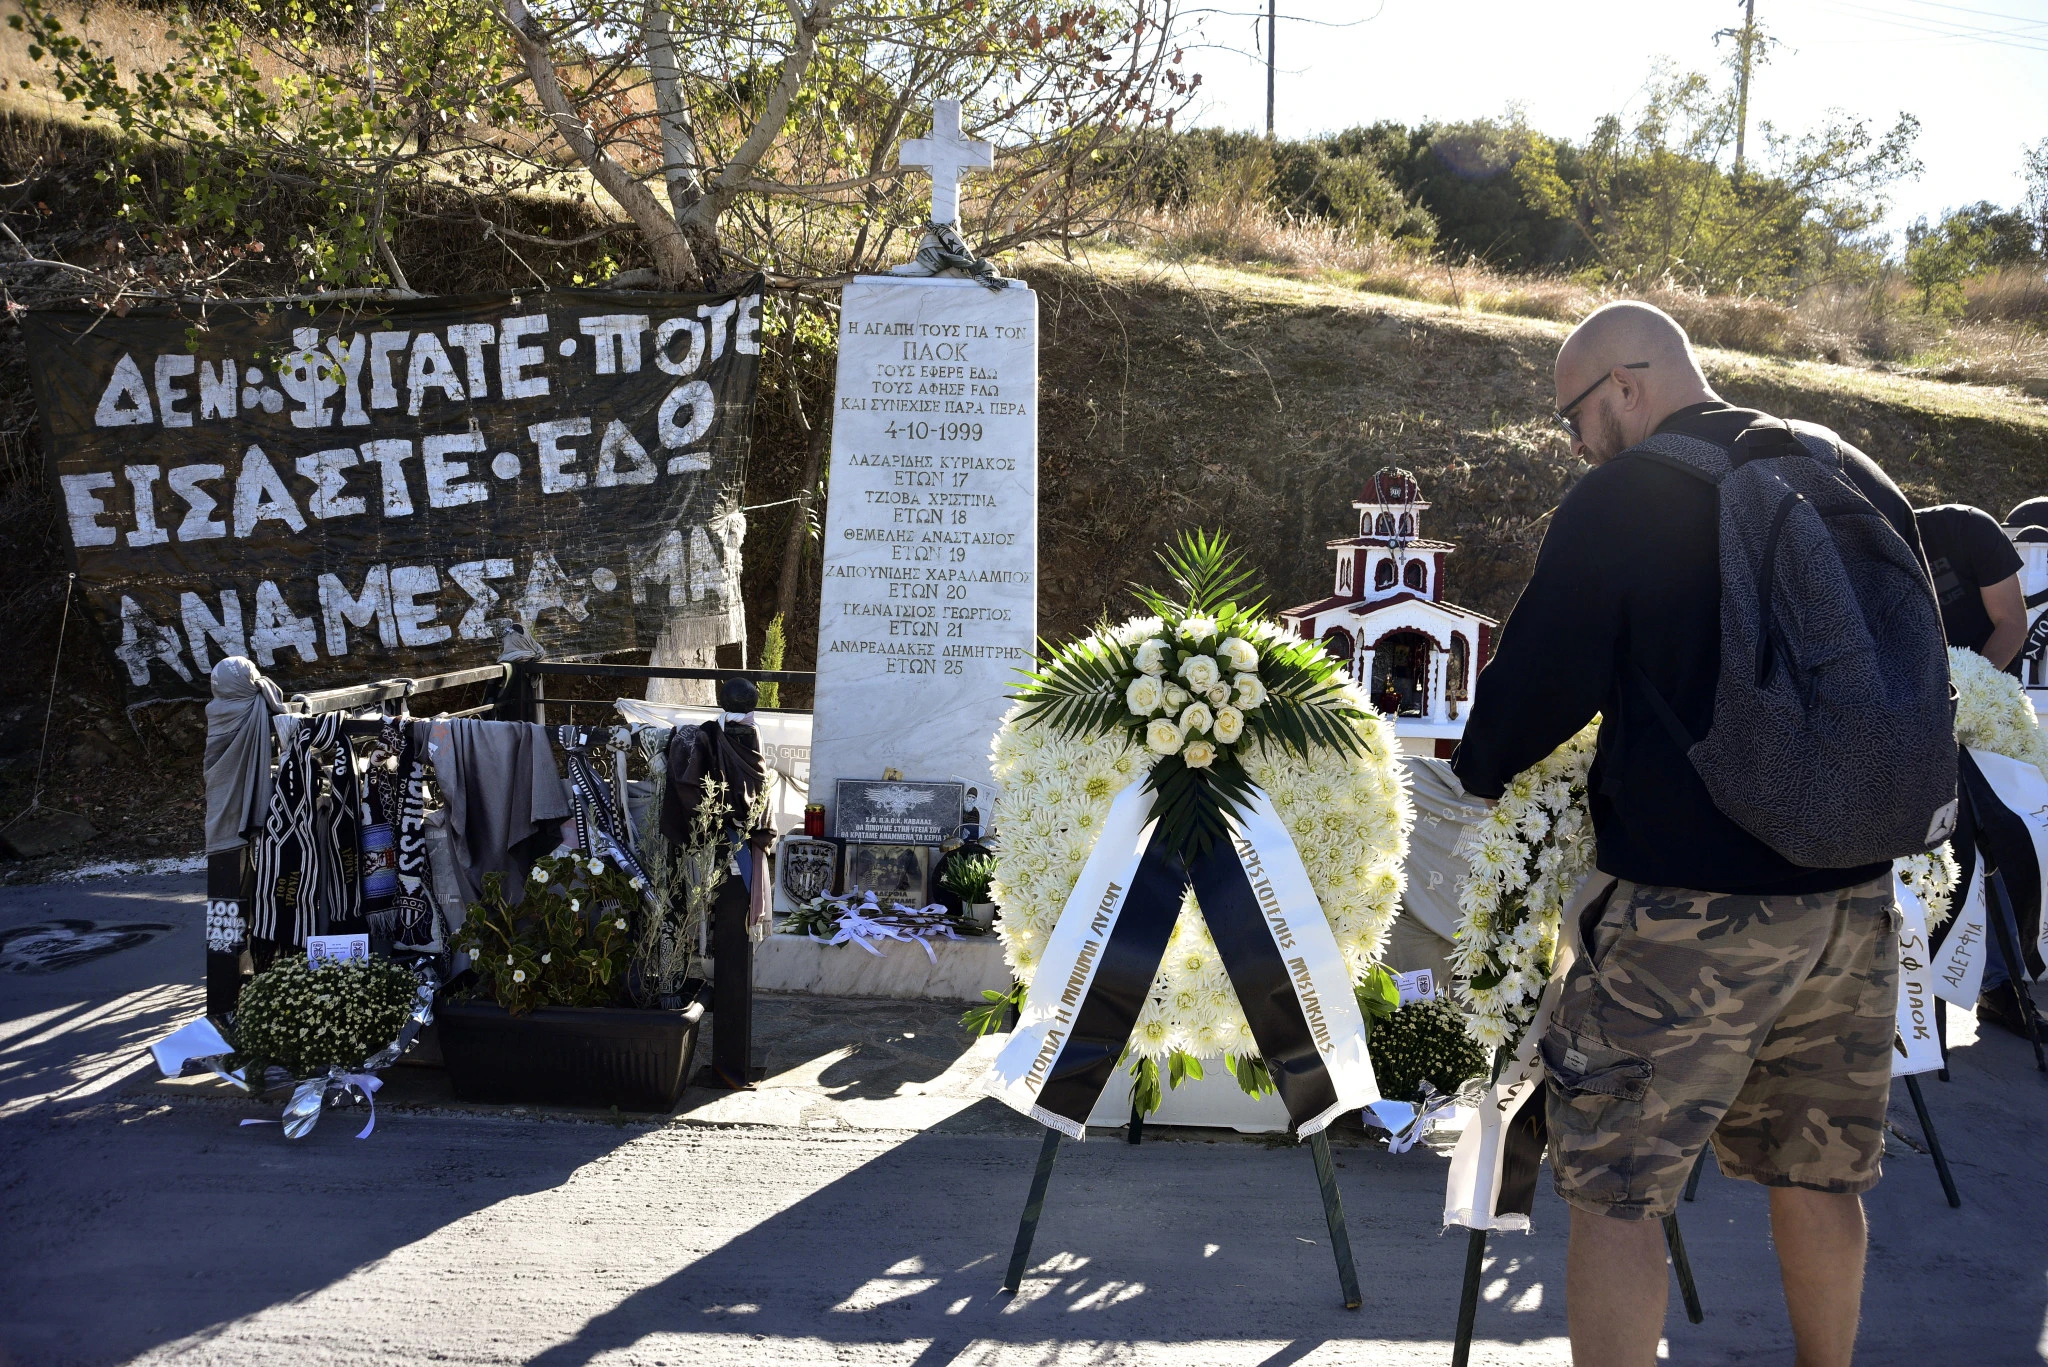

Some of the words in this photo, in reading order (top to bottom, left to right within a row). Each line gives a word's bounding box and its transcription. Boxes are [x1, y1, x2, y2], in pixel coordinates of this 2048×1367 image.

[848, 322, 858, 334] Η
[864, 322, 914, 336] ΑΓΑΠΗ
[920, 324, 960, 337] ΤΟΥΣ
[966, 326, 988, 338] ΓΙΑ
[995, 327, 1027, 339] ΤΟΝ
[903, 341, 968, 362] ΠΑΟΚ
[94, 354, 238, 428] ΔΕΝ
[280, 313, 550, 429] ΦΥΓΑΤΕ
[578, 294, 761, 377] ΠΟΤΕ
[877, 365, 914, 377] ΤΟΥΣ
[921, 366, 963, 379] ΕΦΕΡΕ
[970, 367, 998, 379] ΕΔΩ
[872, 382, 912, 394] ΤΟΥΣ
[918, 383, 965, 396] ΑΦΗΣΕ
[841, 398, 866, 410] ΚΑΙ
[871, 399, 940, 413] ΣΥΝΕΧΙΣΕ
[945, 401, 984, 414] ΠΑΡΑ
[991, 403, 1026, 415] ΠΕΡΑ
[885, 421, 983, 441] 4-10-1999
[849, 454, 932, 468] ΛΑΖΑΡΙΔΗΣ
[940, 457, 1015, 470] ΚΥΡΙΑΚΟΣ
[895, 471, 944, 486] ΕΤΩΝ
[953, 473, 968, 487] 17
[59, 431, 489, 548] ΕΙΣΑΣΤΕ
[865, 491, 920, 505] ΤΖΙΟΒΑ
[928, 493, 996, 507] ΧΡΙΣΤΙΝΑ
[894, 508, 943, 524] ΕΤΩΝ
[951, 510, 967, 524] 18
[844, 529, 914, 542] ΘΕΜΕΛΗΣ
[922, 531, 1014, 545] ΑΝΑΣΤΑΣΙΟΣ
[893, 546, 941, 561] ΕΤΩΝ
[950, 547, 966, 562] 19
[826, 565, 920, 579] ΖΑΠΟΥΝΙΔΗΣ
[926, 569, 1032, 584] ΧΑΡΑΛΑΜΠΟΣ
[889, 583, 938, 599] ΕΤΩΝ
[947, 585, 966, 599] 20
[114, 551, 589, 688] ΑΝΑΜΕΣΑ
[843, 603, 935, 618] ΓΚΑΝΑΤΣΙΟΣ
[943, 607, 1011, 621] ΓΕΩΡΓΙΟΣ
[890, 621, 938, 636] ΕΤΩΝ
[947, 623, 962, 637] 21
[831, 640, 935, 656] ΑΝΔΡΕΑΔΑΚΗΣ
[943, 645, 1021, 659] ΔΗΜΗΤΡΗΣ
[887, 658, 935, 674] ΕΤΩΝ
[944, 660, 963, 675] 25
[1942, 922, 1982, 988] ΑΔΕΡΦΙΑ
[1906, 982, 1930, 1040] ΠΑΟΚ
